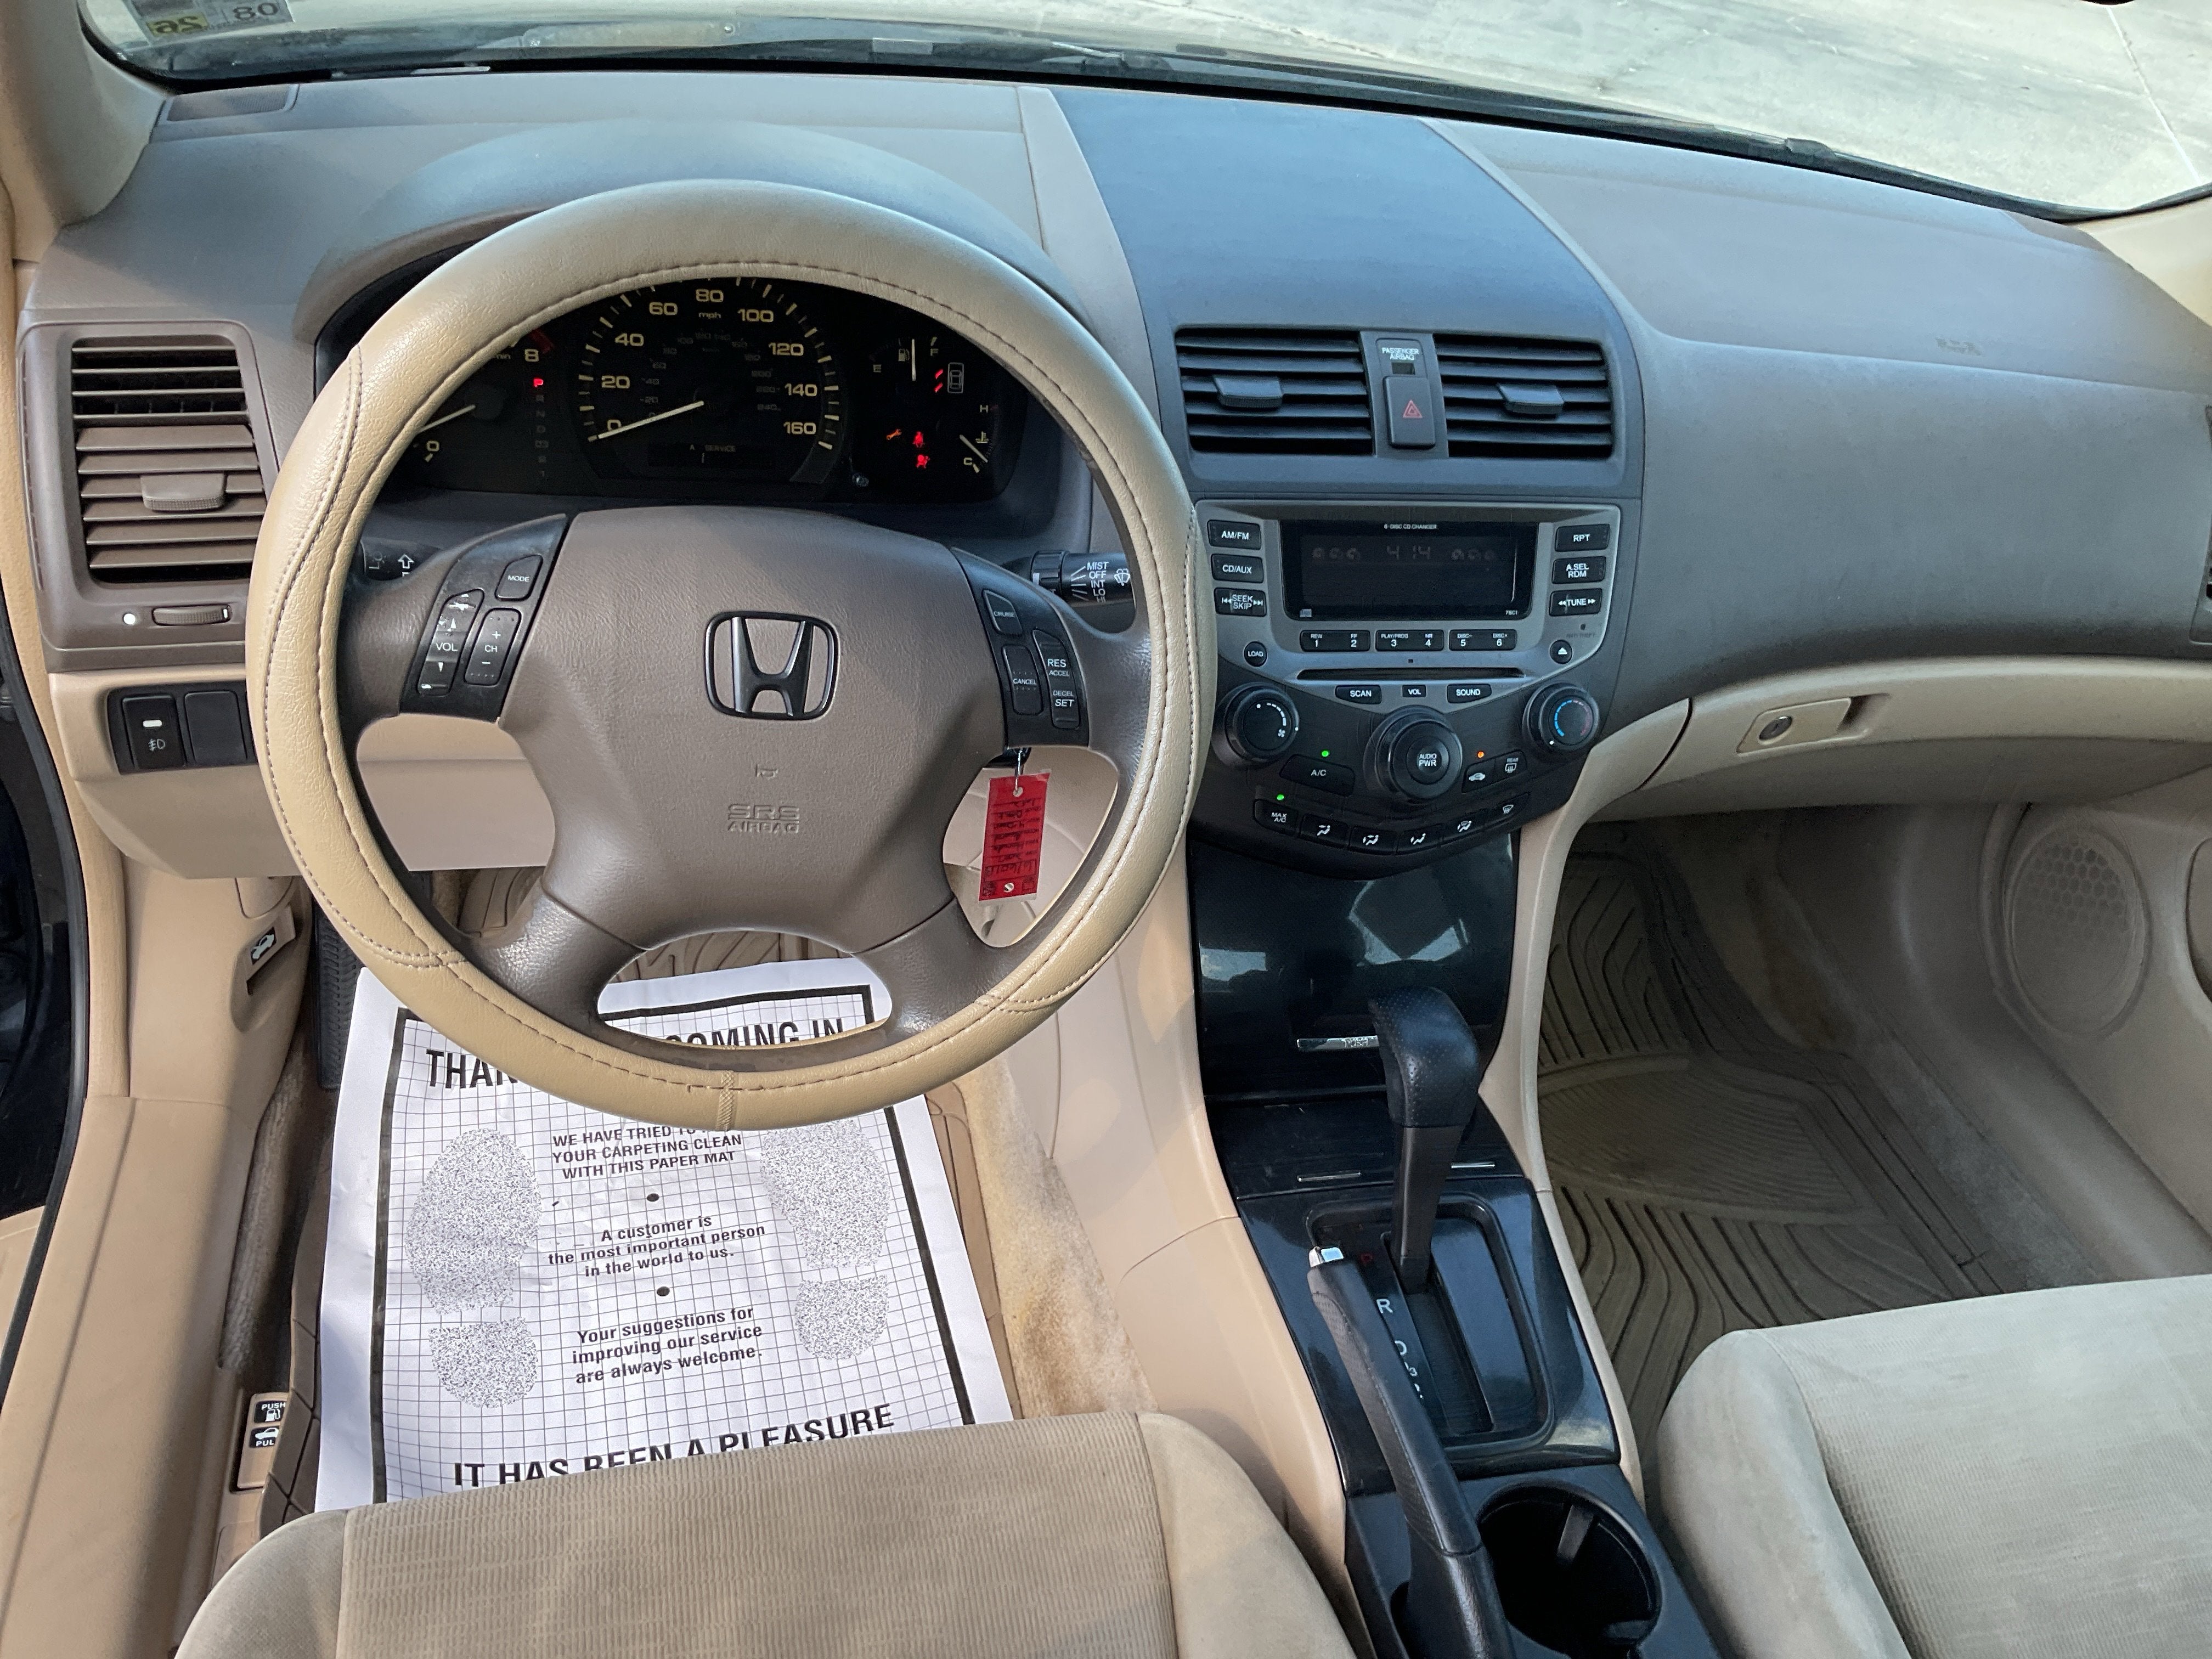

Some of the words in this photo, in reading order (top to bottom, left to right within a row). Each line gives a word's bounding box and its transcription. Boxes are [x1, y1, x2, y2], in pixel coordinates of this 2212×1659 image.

[695, 288, 724, 302] 80
[648, 302, 678, 315] 60
[698, 311, 721, 320] mph
[737, 308, 774, 323] 100
[614, 333, 645, 347] 40
[768, 342, 804, 357] 120
[524, 348, 539, 363] 8
[601, 375, 630, 389] 20
[784, 383, 818, 397] 140
[979, 404, 989, 413] H
[783, 421, 816, 435] 160
[425, 439, 440, 452] 0
[963, 457, 973, 466] C
[1221, 531, 1250, 541] AM/FM
[1573, 534, 1590, 542] RPT
[1087, 561, 1109, 571] MIST
[1222, 564, 1252, 574] CD/AUX
[1566, 563, 1589, 572] A.SEL
[507, 574, 530, 582] MODE
[1088, 571, 1107, 579] OFF
[1568, 570, 1587, 578] RDM
[1090, 579, 1106, 589] INT
[1093, 588, 1106, 597] LO
[1232, 594, 1253, 603] SEEK
[1566, 598, 1587, 607] TUNE
[1232, 601, 1253, 611] SKIP
[436, 642, 459, 652] VOL
[1314, 639, 1319, 647] 1
[1351, 639, 1357, 647] 2
[1391, 639, 1397, 647] 3
[1425, 639, 1431, 647] 4
[1460, 639, 1466, 647] 5
[1496, 639, 1503, 647] 6
[484, 645, 498, 653] CH
[1047, 659, 1067, 668] RES
[1350, 690, 1372, 698] SCAN
[1455, 688, 1481, 697] SOUND
[1054, 699, 1075, 708] SET
[727, 804, 800, 821] SRS
[727, 821, 800, 833] AIRBAG
[552, 1134, 578, 1147] WE
[583, 1128, 622, 1144] HAVE
[625, 1126, 672, 1140] TRIED
[552, 1149, 597, 1164] YOUR
[602, 1139, 689, 1158] CARPETING
[693, 1135, 742, 1150] CLEAN
[562, 1164, 603, 1180] WITH
[608, 1160, 645, 1175] THIS
[650, 1154, 699, 1170] PAPER
[704, 1150, 736, 1164] MAT
[601, 1229, 613, 1242] A
[618, 1218, 693, 1240] customer
[698, 1216, 713, 1229] is
[549, 1252, 574, 1265] the
[580, 1246, 622, 1261] most
[627, 1234, 707, 1254] important
[712, 1224, 766, 1244] person
[585, 1265, 600, 1277] in
[605, 1261, 632, 1274] the
[636, 1252, 684, 1271] world
[688, 1251, 704, 1261] to
[710, 1248, 735, 1259] us.
[1376, 1298, 1393, 1314] R
[578, 1329, 617, 1344] Your
[622, 1311, 726, 1335] suggestions
[730, 1307, 754, 1321] for
[573, 1341, 662, 1363] improving
[667, 1335, 695, 1350] our
[701, 1325, 763, 1345] service
[576, 1371, 605, 1384] are
[611, 1360, 673, 1377] always
[677, 1347, 763, 1368] welcome.
[261, 1402, 286, 1410] PUSH
[256, 1439, 276, 1447] PUL
[454, 1462, 486, 1488] IT
[499, 1458, 569, 1485] HAS
[687, 1438, 706, 1456] A
